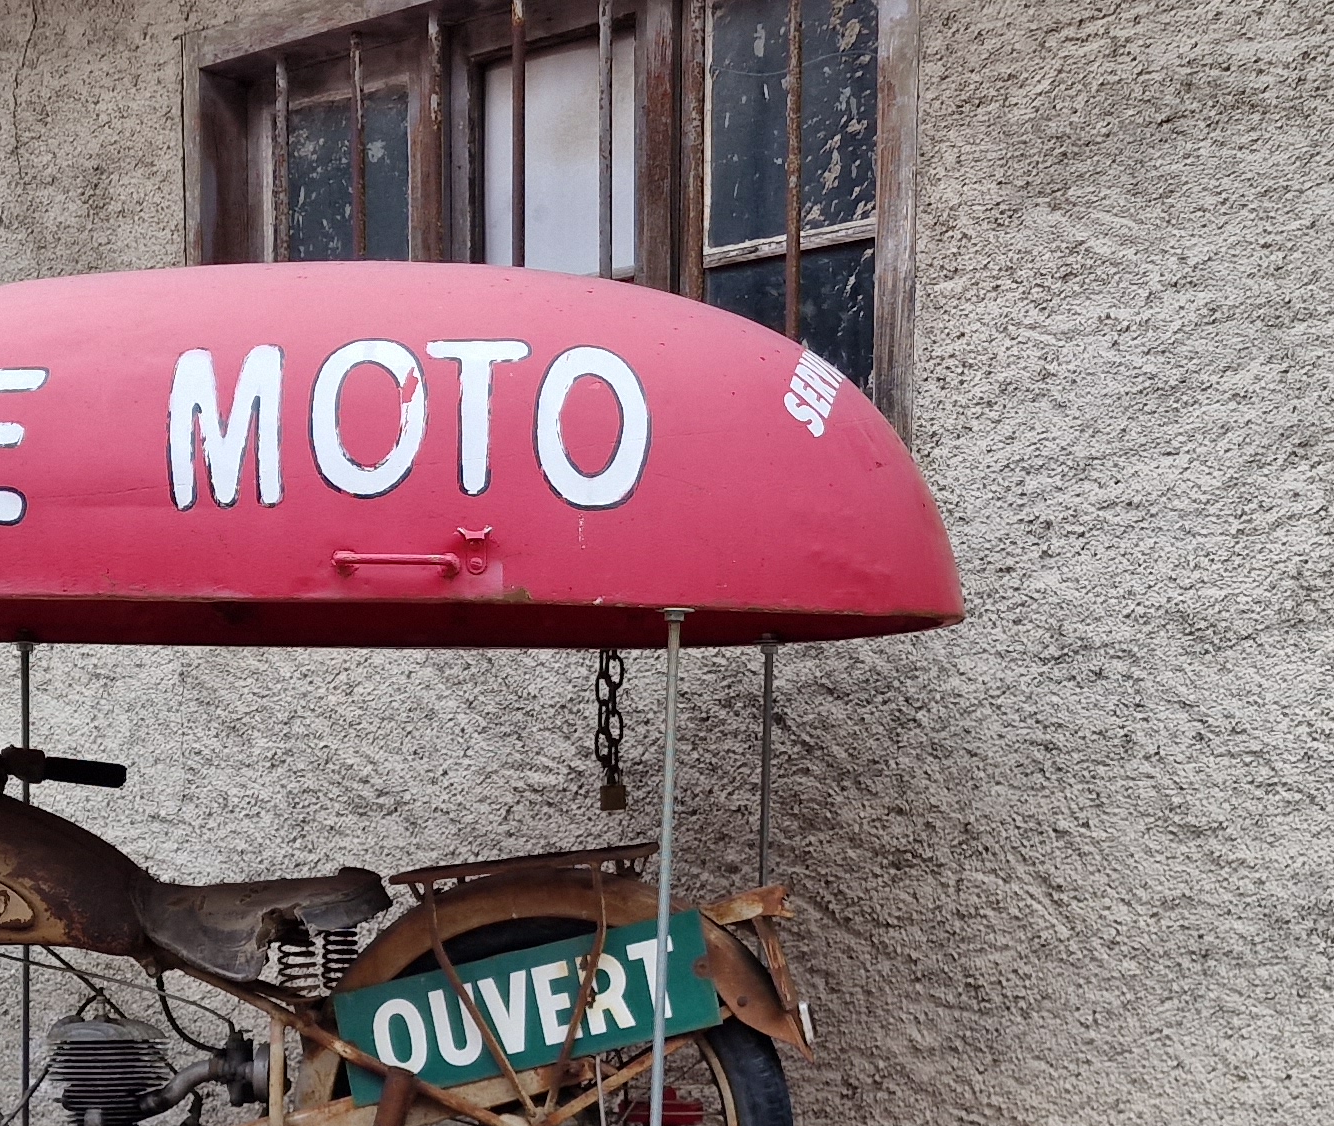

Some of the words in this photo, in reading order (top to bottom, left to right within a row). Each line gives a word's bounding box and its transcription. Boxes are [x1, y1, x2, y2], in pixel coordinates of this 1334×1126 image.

[165, 336, 652, 512] MOTO
[783, 348, 847, 438] SERVI
[371, 935, 674, 1075] OUVERT
